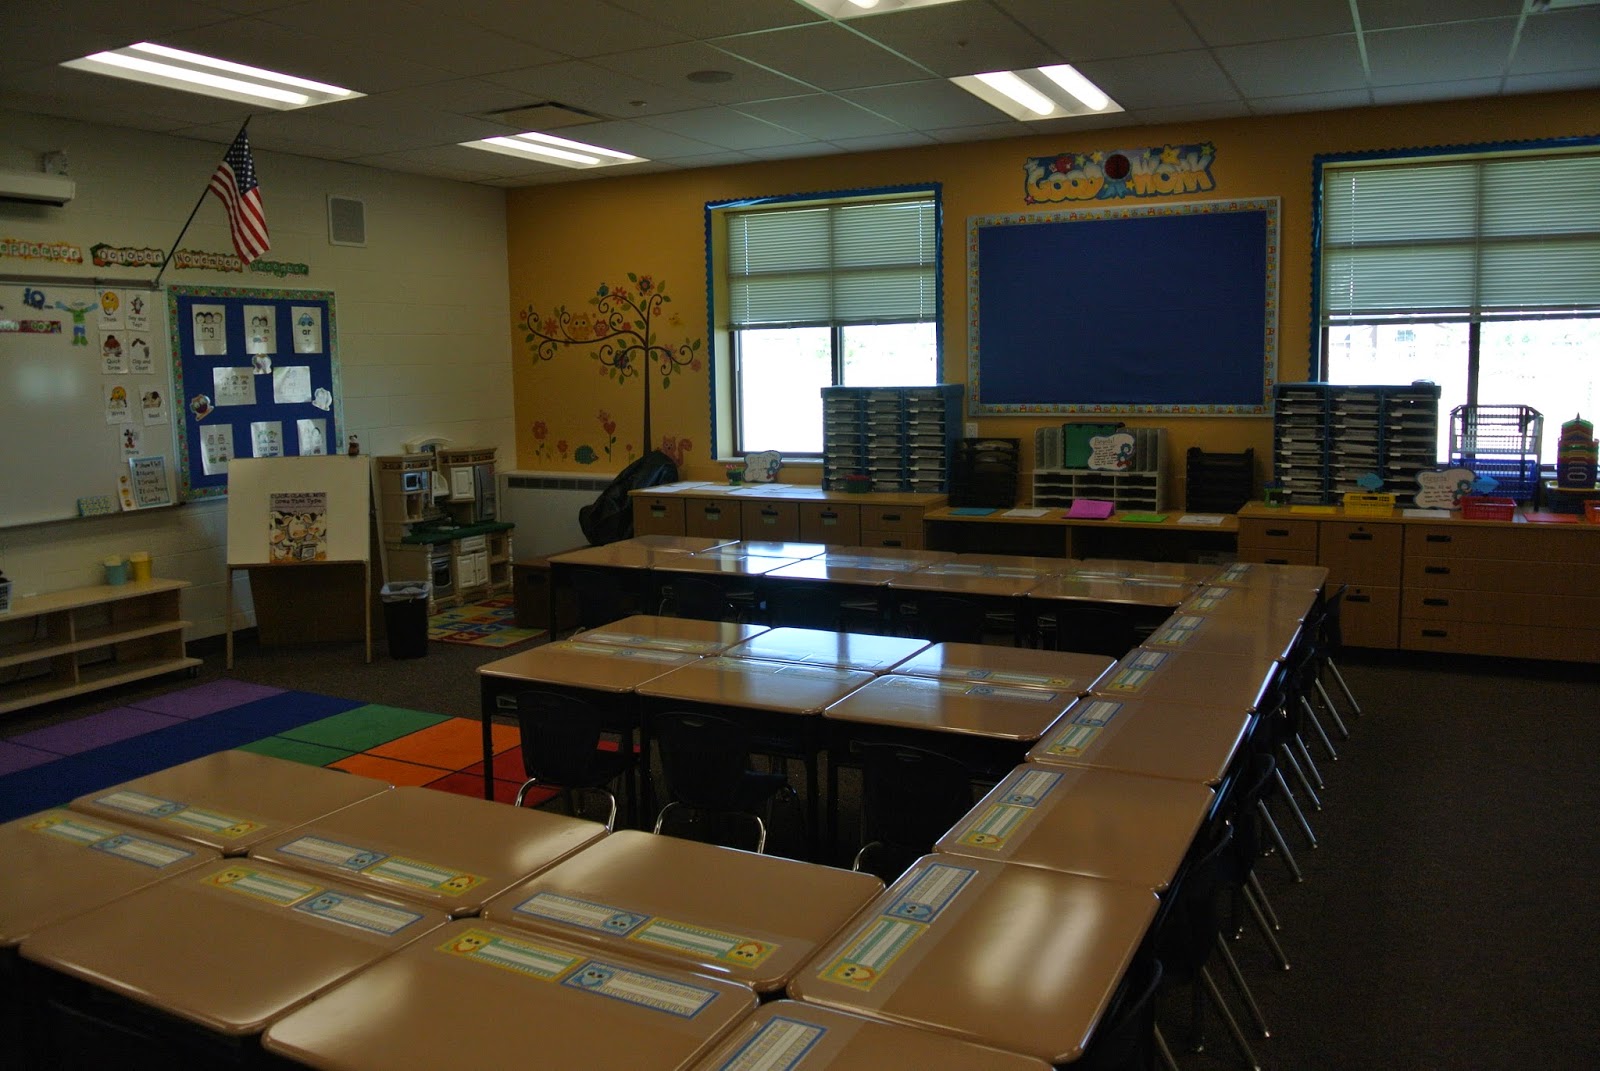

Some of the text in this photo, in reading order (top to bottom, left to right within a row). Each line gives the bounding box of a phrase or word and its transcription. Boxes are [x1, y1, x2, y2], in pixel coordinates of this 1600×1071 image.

[0, 243, 77, 257] eptember
[177, 254, 239, 267] November
[201, 324, 214, 338] ing
